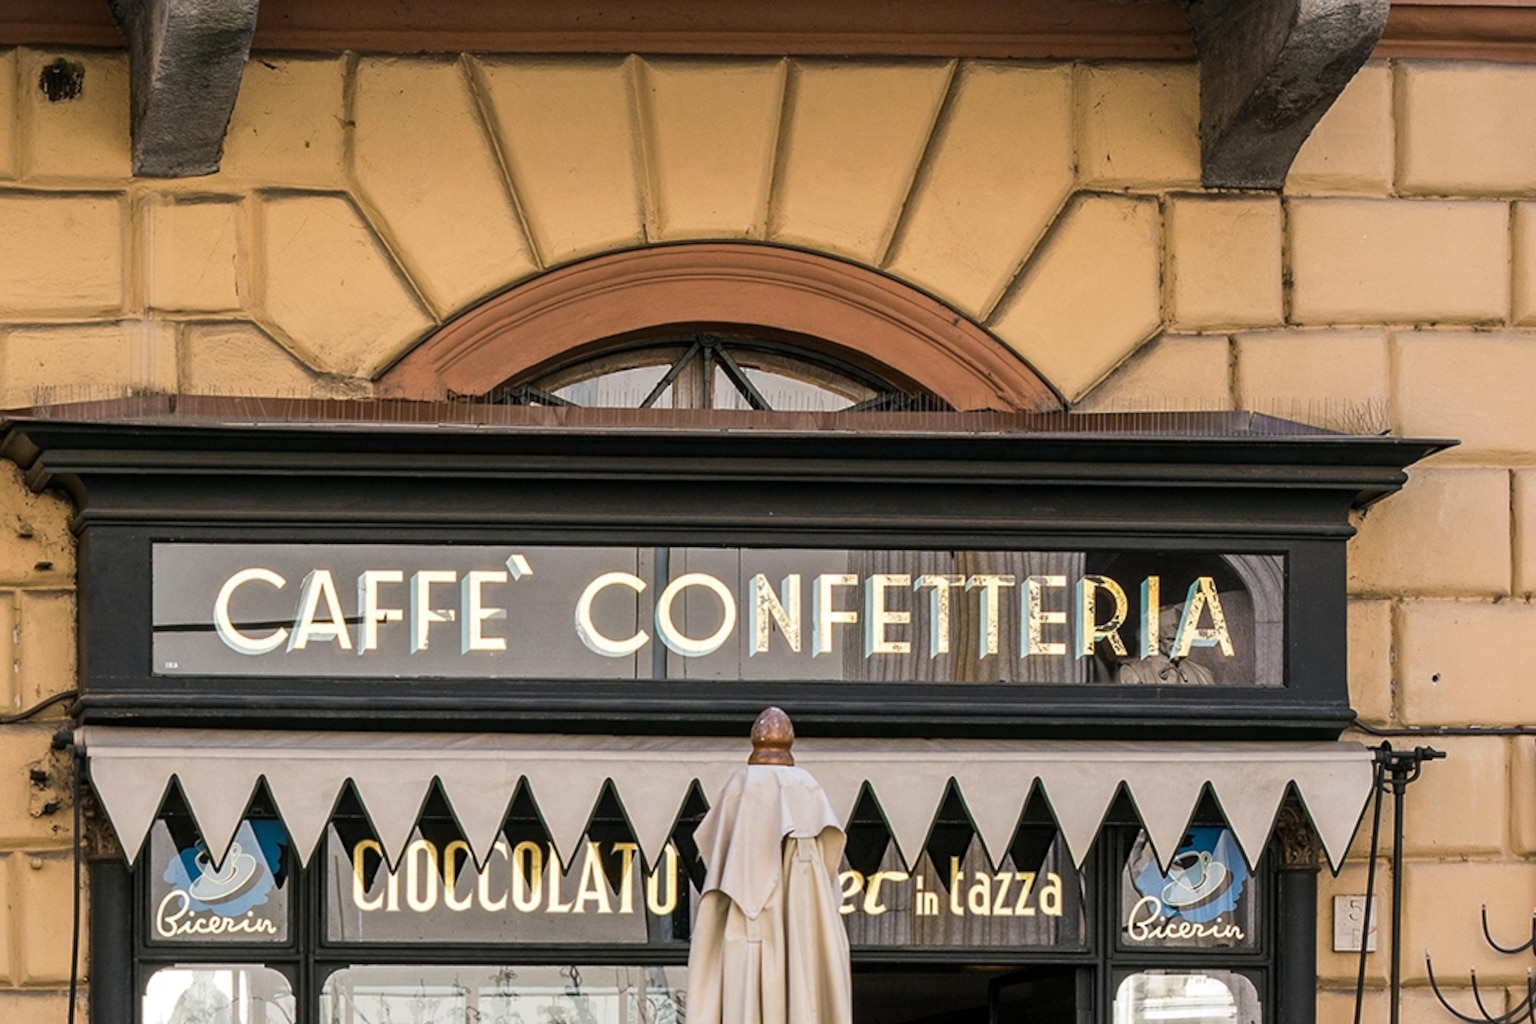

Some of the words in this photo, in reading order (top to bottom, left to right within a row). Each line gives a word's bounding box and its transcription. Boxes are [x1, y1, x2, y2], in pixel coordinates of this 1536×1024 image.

[574, 570, 1235, 659] CONFETTERIA
[351, 839, 679, 916] CIOCCOLATO
[915, 875, 940, 916] in
[950, 856, 1063, 917] tazza
[156, 889, 277, 937] Bicerin
[1128, 895, 1244, 941] Bicerin
